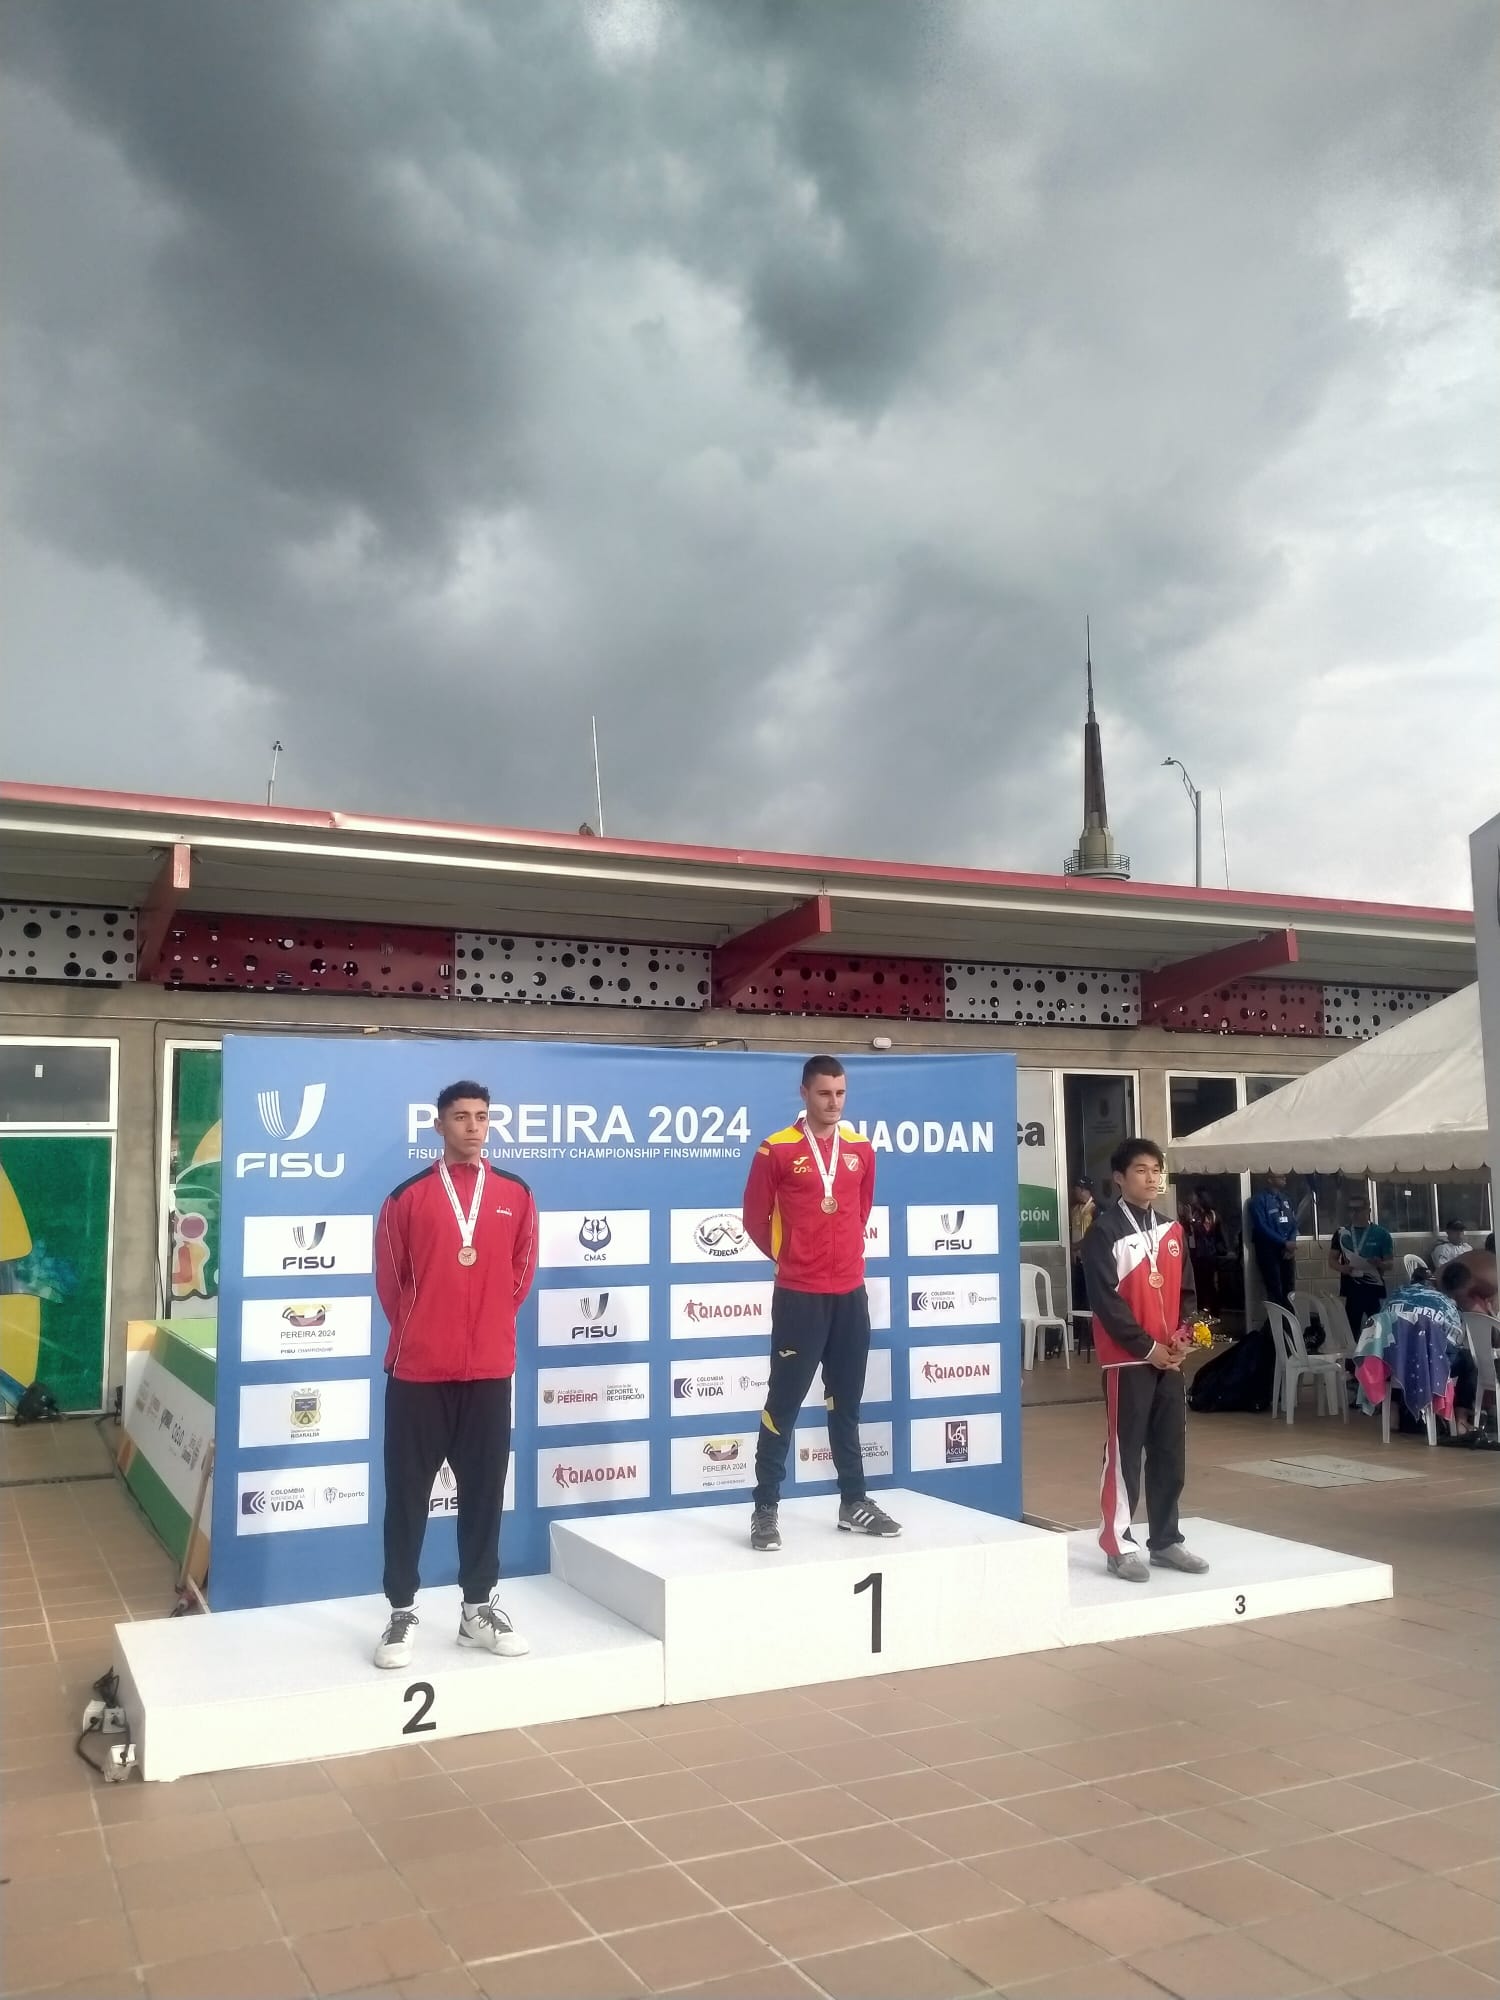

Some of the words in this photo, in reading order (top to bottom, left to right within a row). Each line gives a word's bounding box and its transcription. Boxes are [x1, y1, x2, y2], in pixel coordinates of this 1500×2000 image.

[408, 1103, 636, 1144] PREIRA
[648, 1105, 752, 1144] 2024
[408, 1148, 437, 1160] FISU
[493, 1148, 566, 1160] UNIVERSITY
[570, 1147, 661, 1159] CHAMPIONSHIP
[664, 1147, 741, 1159] FINSWIMMING
[236, 1152, 345, 1179] FISU
[934, 1239, 973, 1251] FISU
[583, 1253, 607, 1262] CMAS
[708, 1247, 739, 1257] FEDECAS
[282, 1255, 336, 1270] FISU
[699, 1303, 762, 1319] QIAODAN
[931, 1301, 955, 1310] VIDA
[280, 1330, 316, 1339] PEREIRA
[318, 1329, 336, 1337] 2024
[571, 1324, 618, 1340] FISU
[935, 1364, 990, 1380] QIAODAN
[606, 1388, 634, 1396] DEPORTE
[696, 1386, 724, 1397] VIDA
[557, 1392, 598, 1404] PEREIRA
[812, 1452, 834, 1462] PERE
[946, 1447, 968, 1455] ASCUN
[569, 1464, 637, 1484] QIAODAN
[702, 1464, 732, 1473] PEREIRA
[270, 1487, 305, 1496] COLOMBIA
[338, 1490, 365, 1499] Deporte
[271, 1499, 304, 1513] VIDA
[430, 1496, 459, 1512] FIS
[1234, 1594, 1246, 1615] 3
[854, 1572, 882, 1654] 1
[402, 1681, 437, 1735] 2
